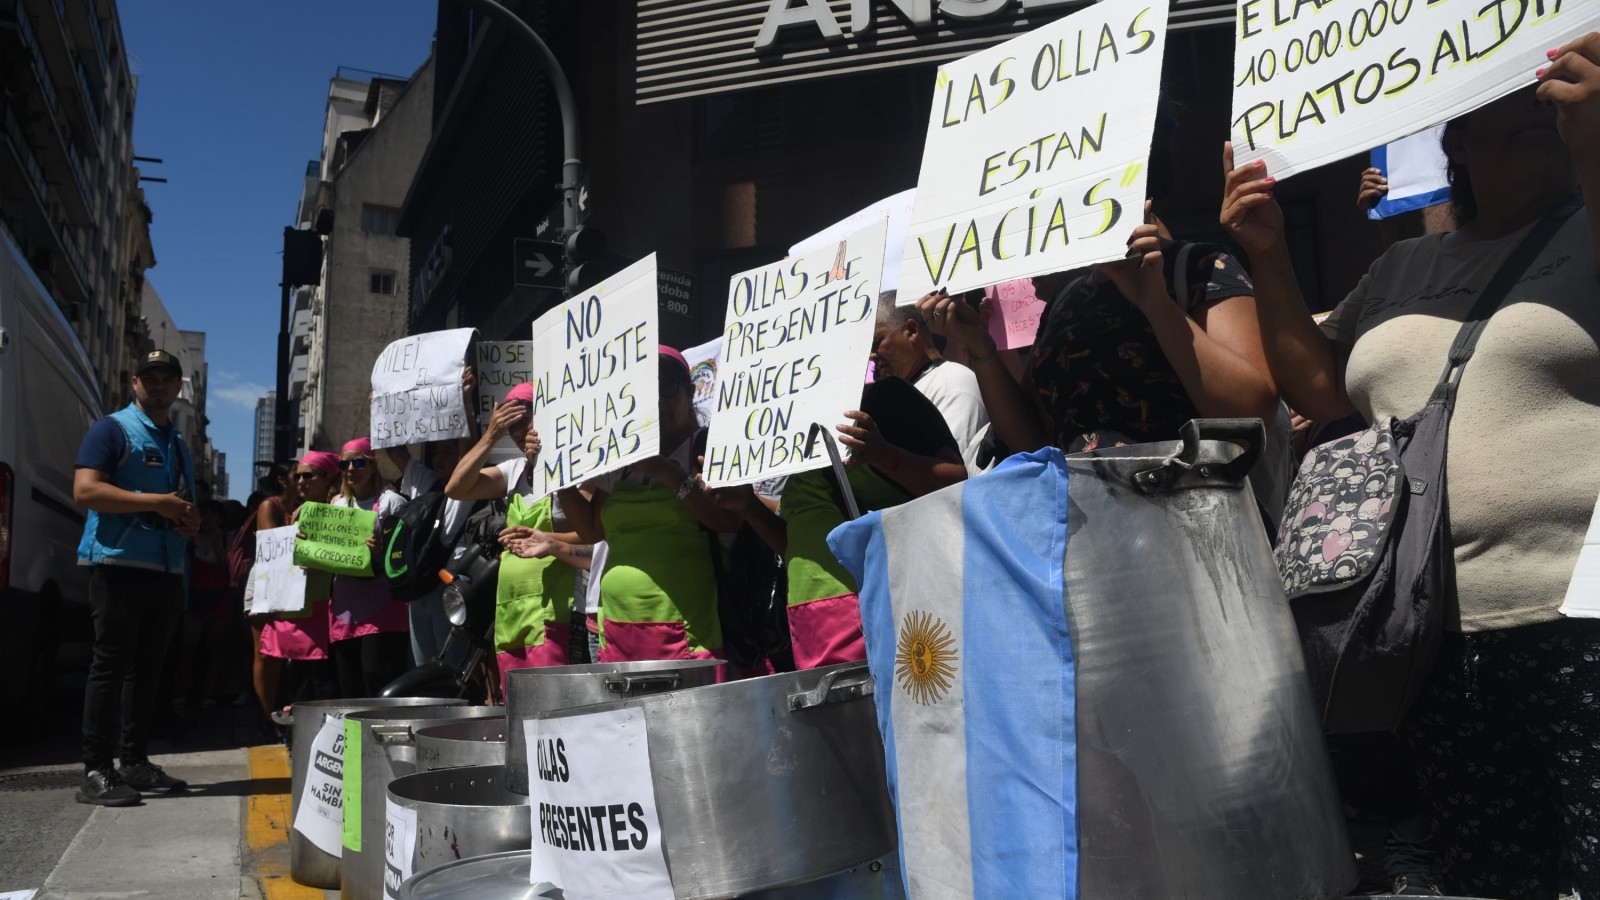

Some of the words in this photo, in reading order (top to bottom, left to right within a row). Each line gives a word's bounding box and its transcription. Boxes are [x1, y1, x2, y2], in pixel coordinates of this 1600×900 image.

[1031, 7, 1156, 91] OLLAS
[1232, 48, 1421, 151] PLATOS
[979, 112, 1107, 197] ESTAN
[667, 300, 688, 314] 800
[733, 258, 809, 318] OLLAS
[566, 295, 602, 350] NO
[416, 367, 433, 386] EL
[479, 344, 501, 364] NO
[505, 344, 526, 364] SE
[534, 371, 557, 416] AL
[560, 320, 648, 399] AJUSTE
[429, 386, 449, 409] NO
[479, 369, 533, 388] AJUST
[717, 354, 822, 413] NIÑECES
[555, 405, 585, 450] EN
[593, 382, 636, 433] LAS
[744, 400, 795, 441] CON
[544, 419, 641, 494] MESAS
[707, 431, 822, 482] HAMBRE
[300, 521, 360, 537] AMPLIACIONES
[302, 506, 345, 520] AUMENTO
[316, 754, 343, 776] ARGEN
[537, 737, 570, 783] OLLAS
[322, 782, 341, 798] SIN
[539, 802, 649, 851] PRESENTES
